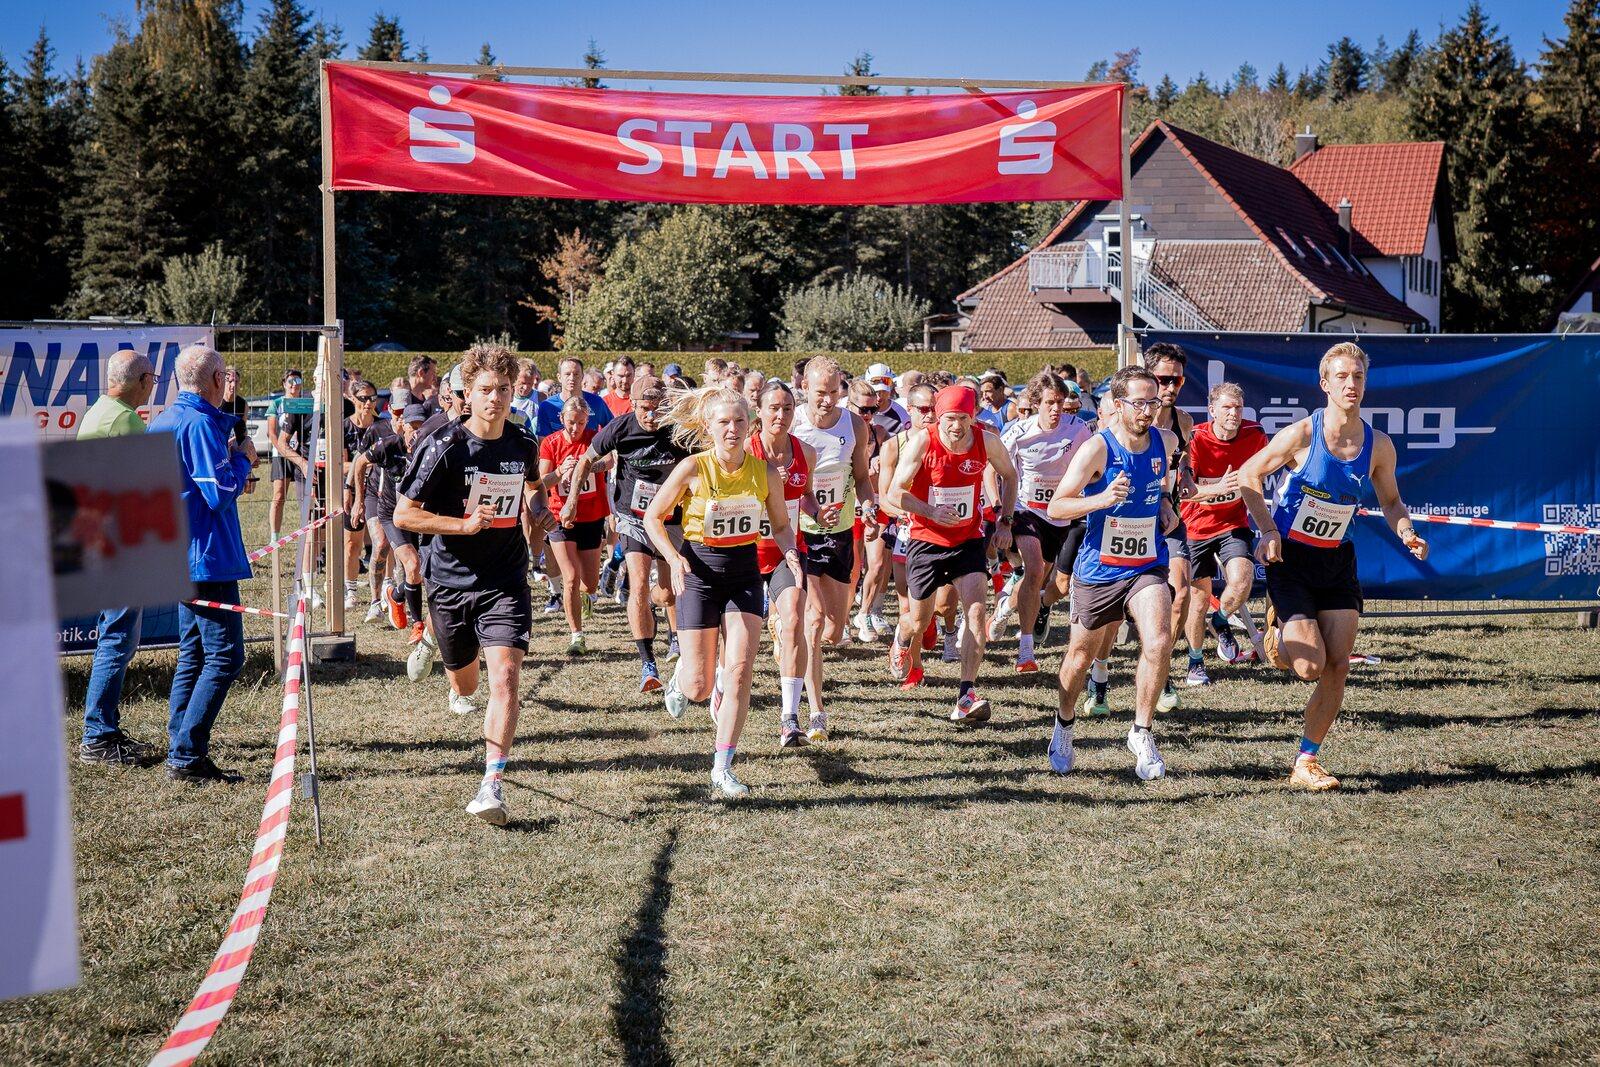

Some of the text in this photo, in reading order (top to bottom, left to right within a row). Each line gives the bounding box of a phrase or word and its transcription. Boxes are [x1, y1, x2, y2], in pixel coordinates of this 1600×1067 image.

[617, 118, 869, 181] START
[816, 488, 835, 505] 61
[1407, 503, 1489, 517] tudiengänge
[713, 516, 752, 536] 516
[1302, 515, 1343, 538] 607
[1110, 536, 1148, 556] 596
